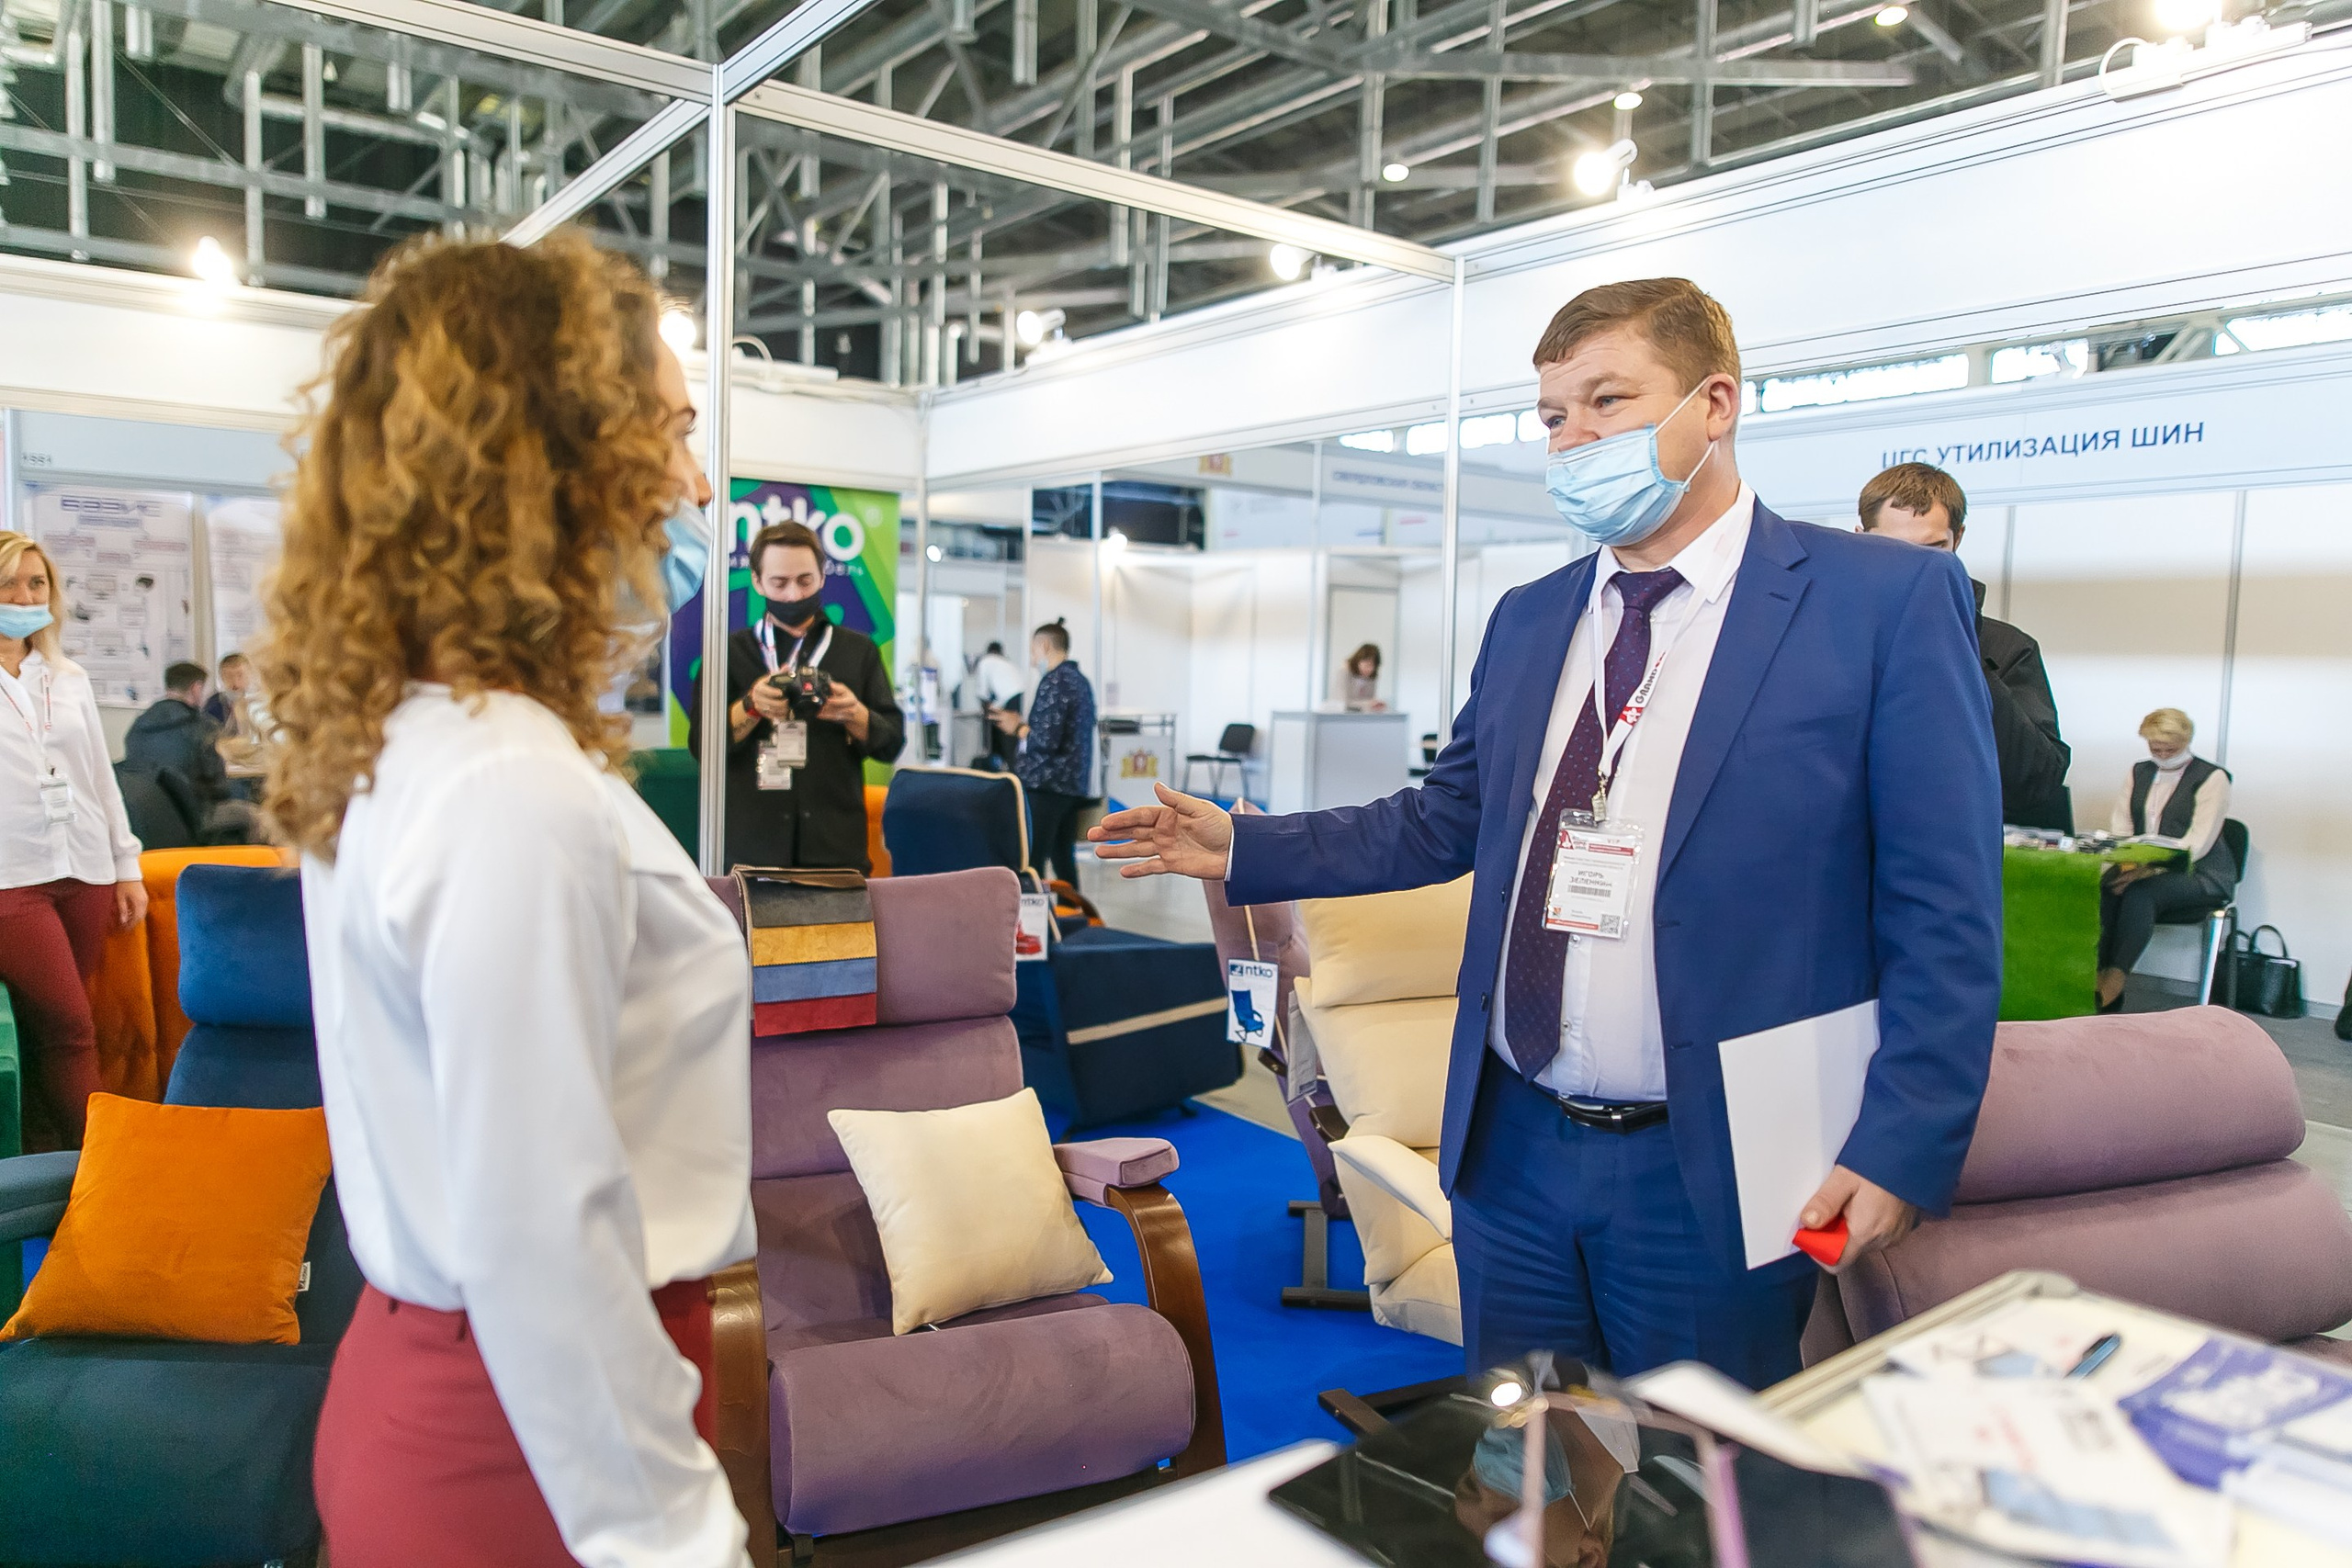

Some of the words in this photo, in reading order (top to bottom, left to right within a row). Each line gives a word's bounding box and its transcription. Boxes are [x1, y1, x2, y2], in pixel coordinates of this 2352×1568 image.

[1937, 430, 2120, 465] УТИЛИЗАЦИЯ
[2132, 422, 2204, 447] ШИН
[1245, 964, 1273, 978] ntko
